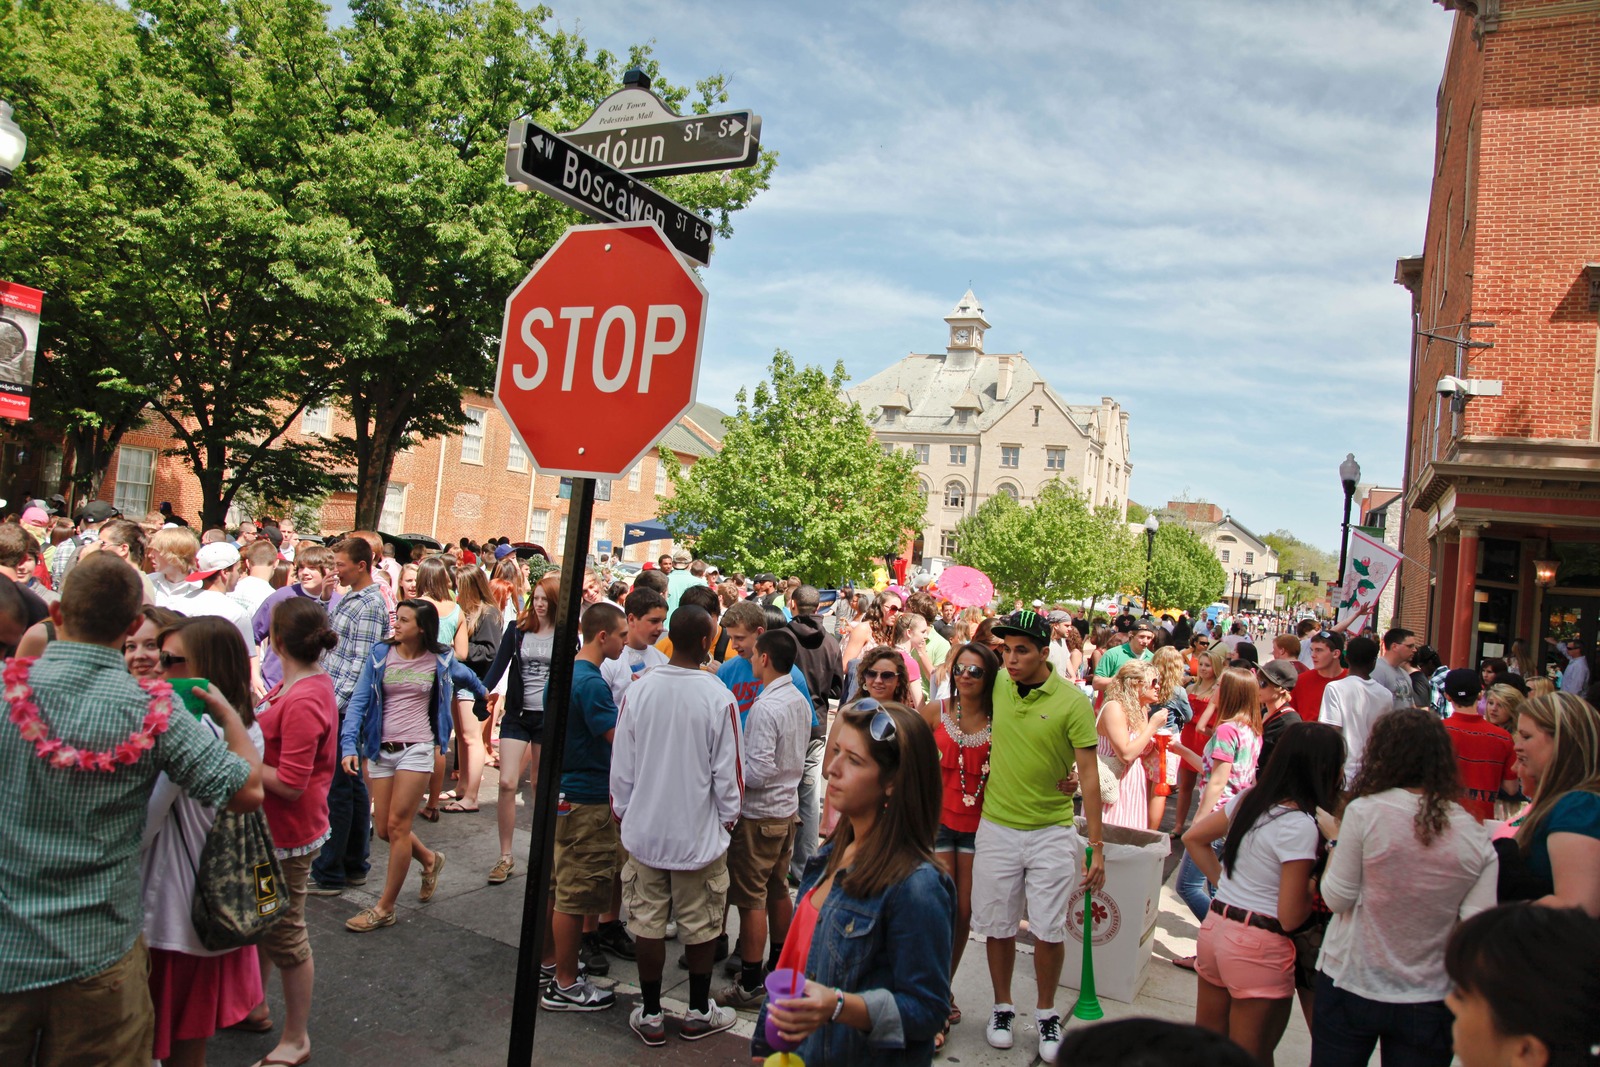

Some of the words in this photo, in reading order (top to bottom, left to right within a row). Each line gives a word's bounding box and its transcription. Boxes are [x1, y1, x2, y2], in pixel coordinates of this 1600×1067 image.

[599, 115, 634, 125] Pedestrian
[637, 111, 653, 120] Mall
[608, 104, 623, 112] Old
[627, 102, 646, 110] Town
[683, 122, 703, 142] ST
[718, 119, 728, 138] S
[545, 137, 555, 160] W
[563, 149, 665, 232] Boscawen
[676, 212, 688, 232] ST
[694, 222, 701, 240] E
[512, 304, 687, 394] STOP
